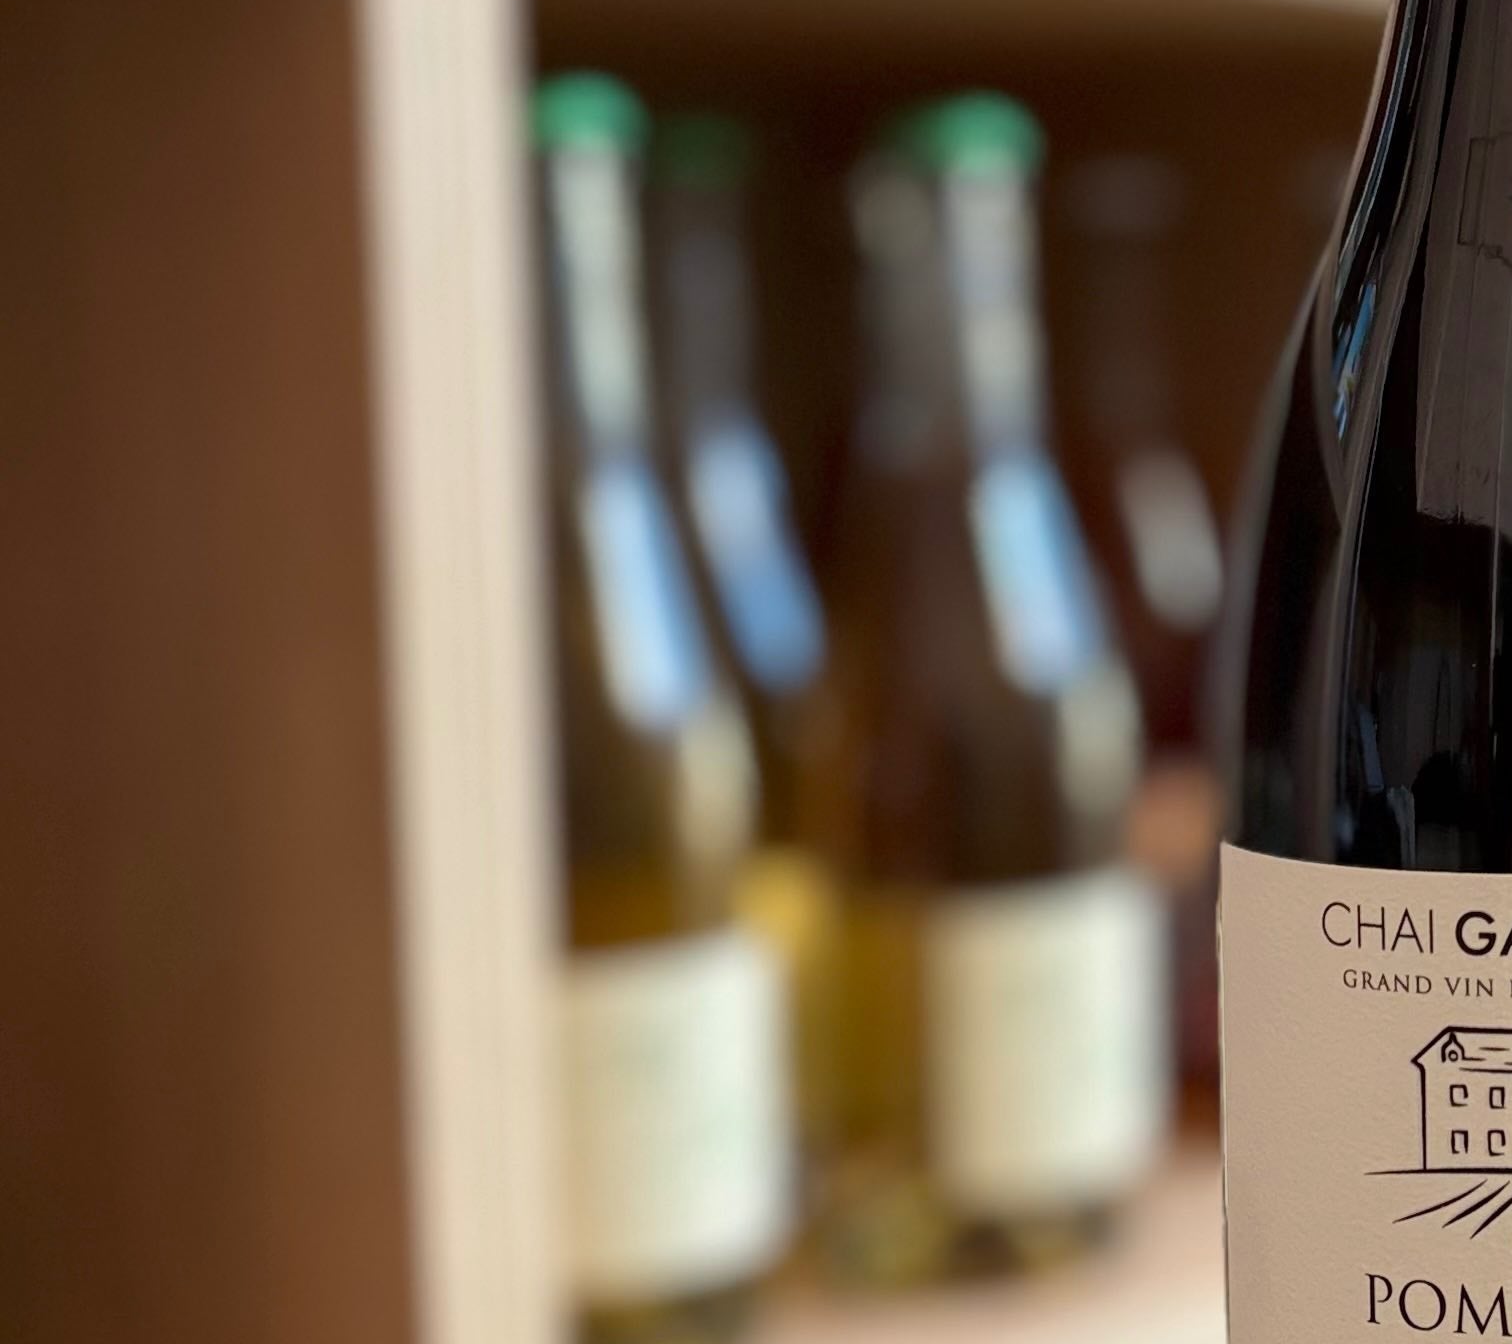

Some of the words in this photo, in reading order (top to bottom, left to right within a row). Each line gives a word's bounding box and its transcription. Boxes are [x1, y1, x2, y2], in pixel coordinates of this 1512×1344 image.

[1321, 901, 1434, 954] CHAI
[1342, 968, 1433, 995] GRAND
[1444, 976, 1494, 998] VIN
